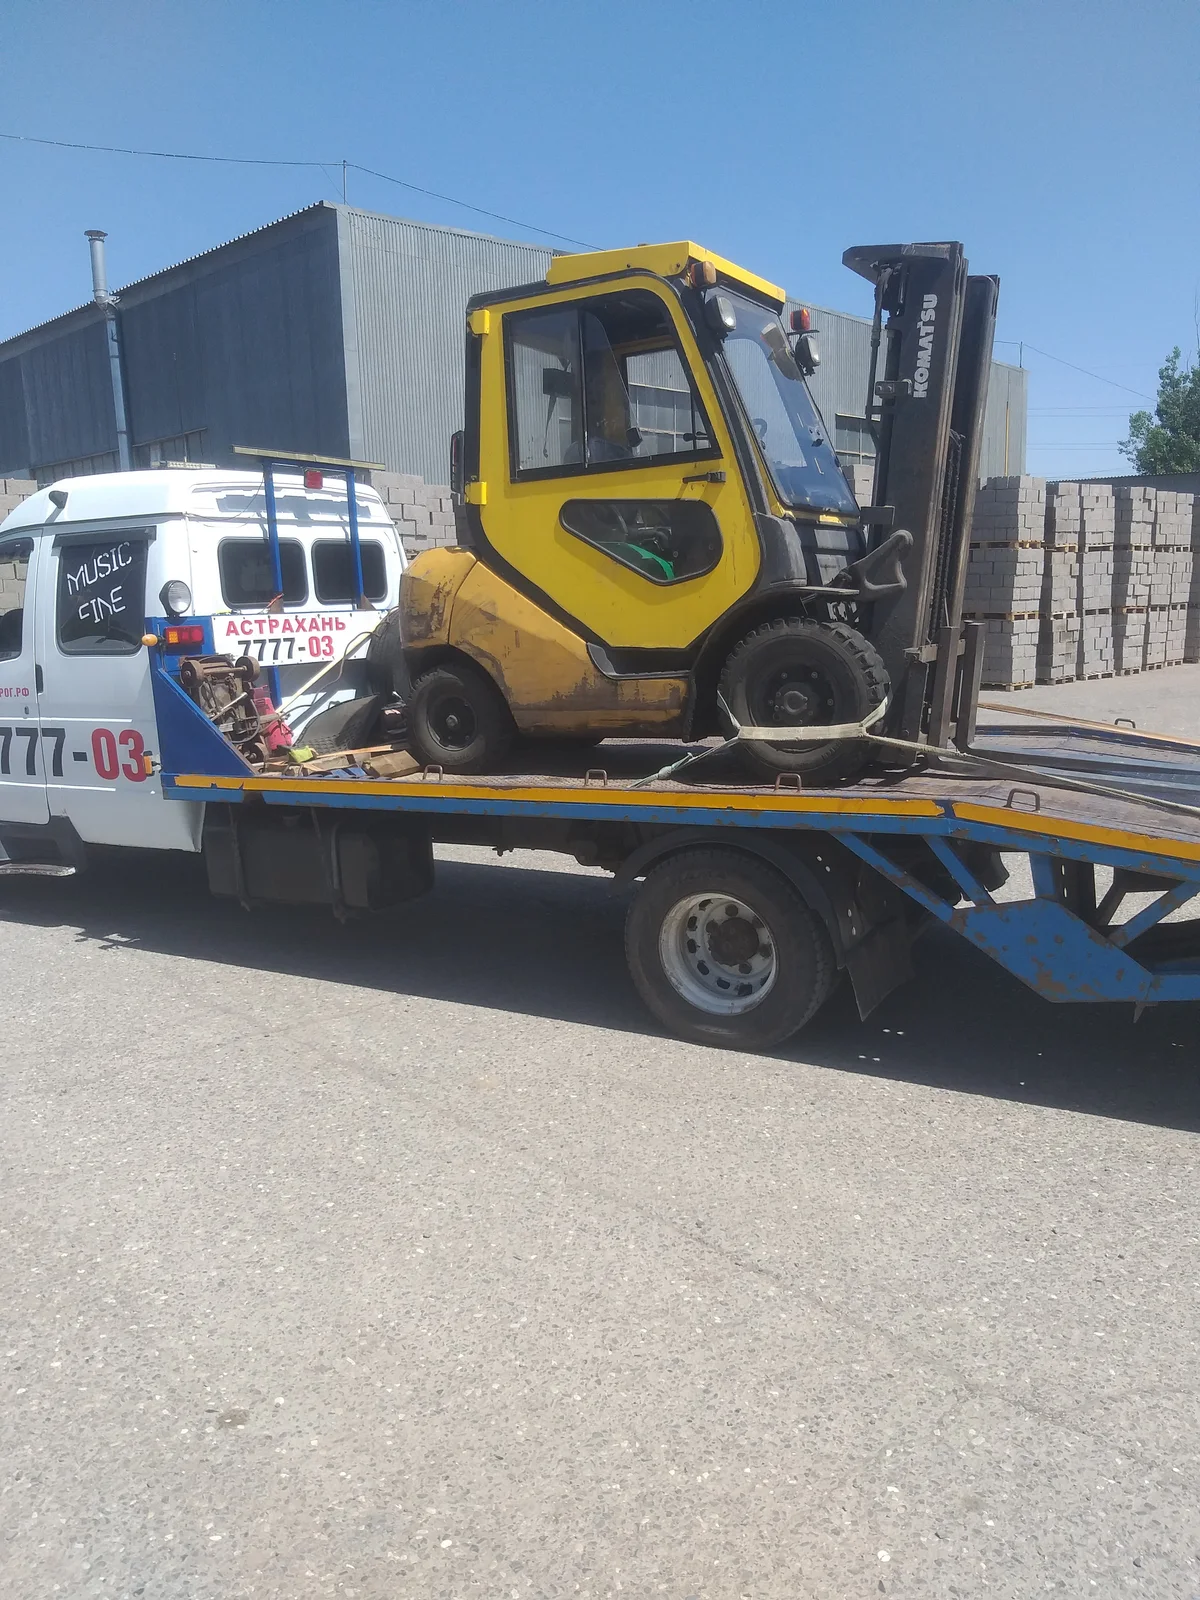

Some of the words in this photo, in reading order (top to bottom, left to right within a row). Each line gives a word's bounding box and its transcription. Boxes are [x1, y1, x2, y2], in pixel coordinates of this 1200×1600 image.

[913, 293, 938, 398] KOMATSU
[66, 541, 132, 596] MUSIC
[225, 616, 346, 636] АСТРАХАНЬ
[237, 635, 335, 662] 7777-03
